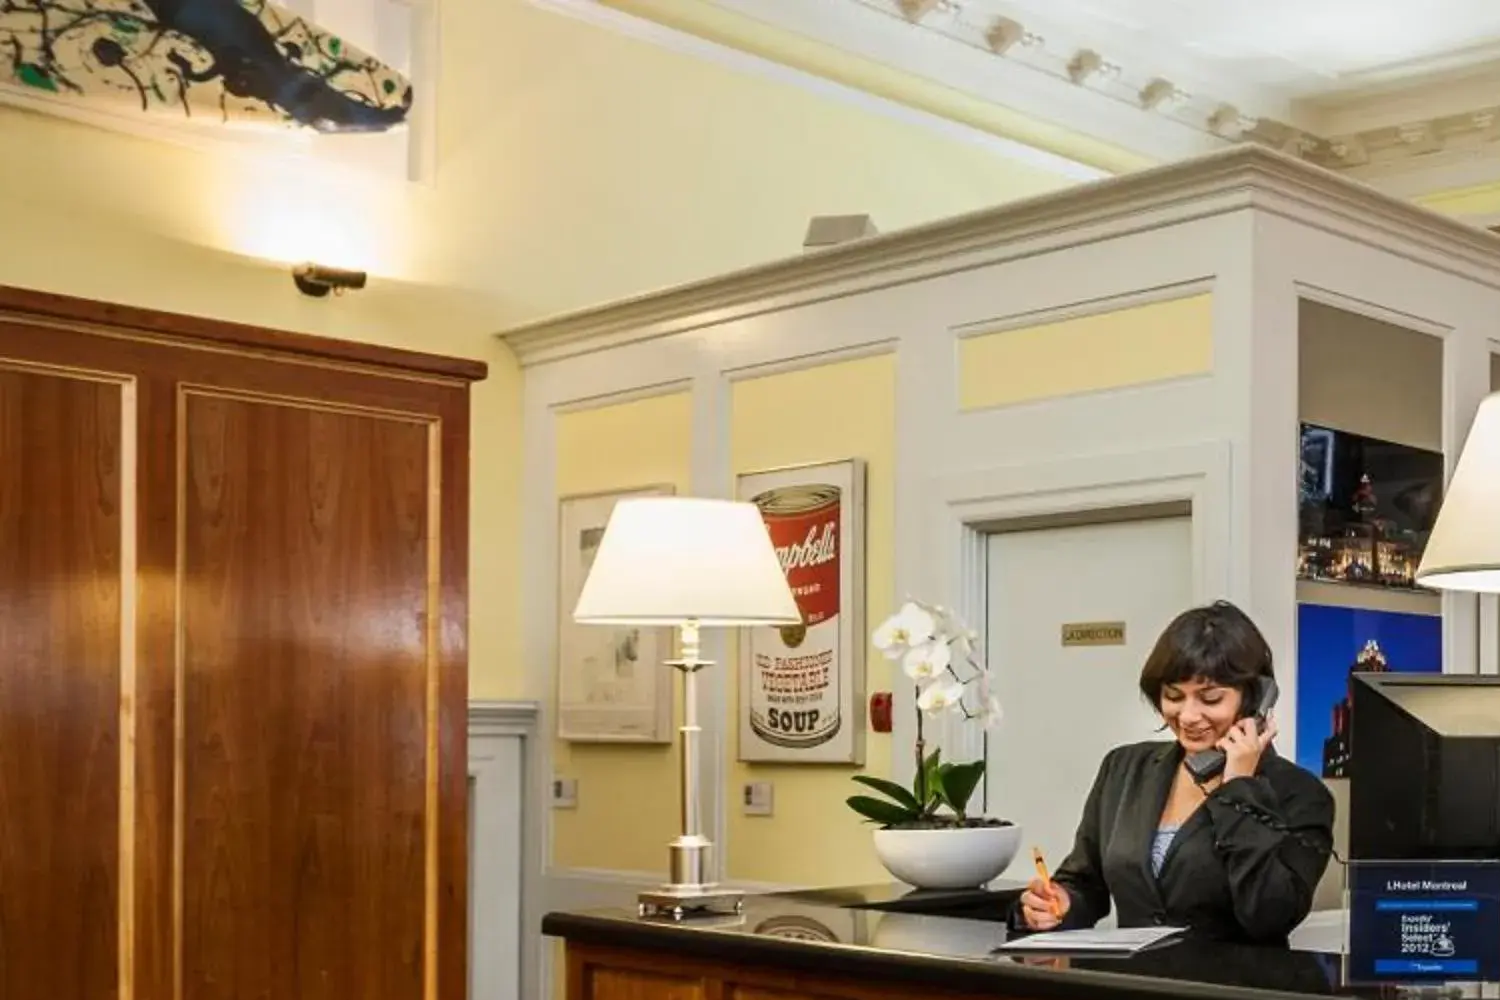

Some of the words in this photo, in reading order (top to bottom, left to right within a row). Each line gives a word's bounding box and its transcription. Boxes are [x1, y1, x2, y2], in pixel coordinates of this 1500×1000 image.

[768, 707, 819, 732] SOUP
[1422, 880, 1468, 891] Montreal
[1401, 943, 1430, 953] 2012
